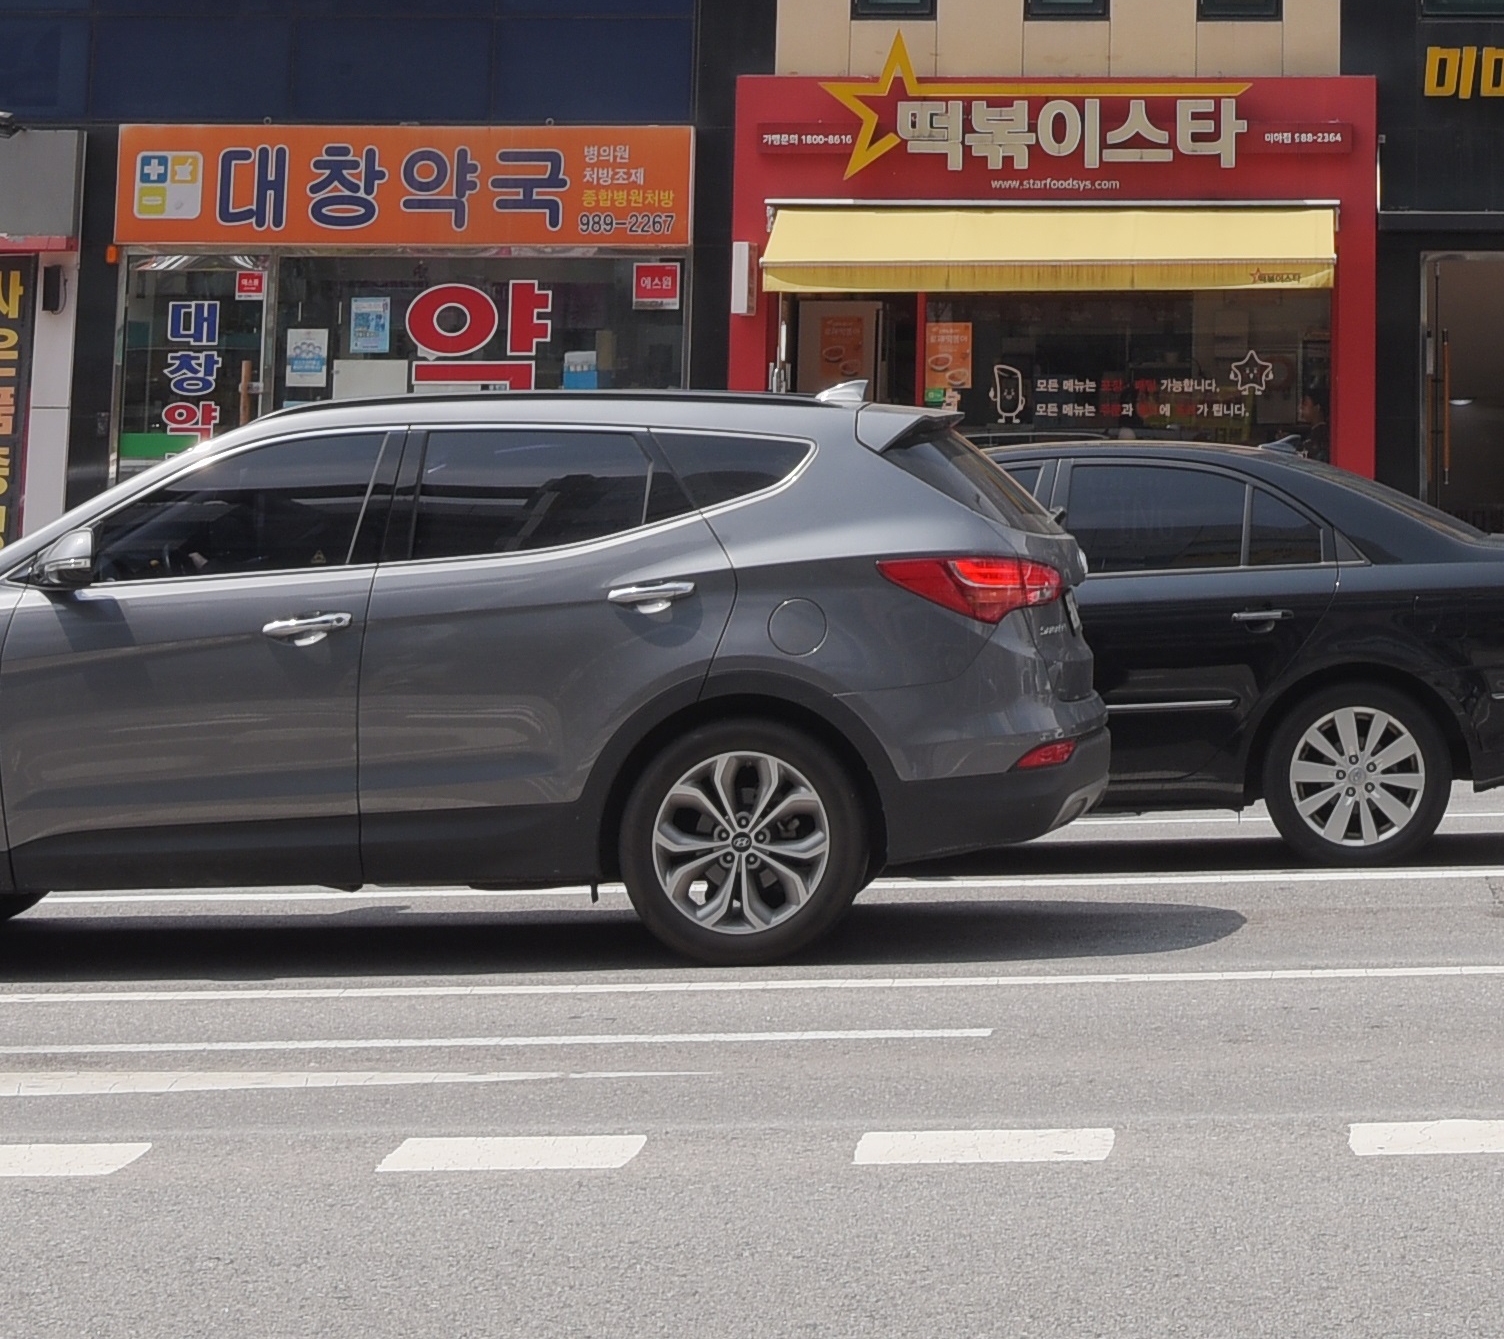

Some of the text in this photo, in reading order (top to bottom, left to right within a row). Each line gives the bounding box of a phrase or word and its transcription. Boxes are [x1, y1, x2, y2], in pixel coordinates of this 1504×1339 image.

[895, 97, 1248, 172] 떡볶이스타
[583, 145, 631, 164] 병의원
[582, 167, 645, 186] 처방조제
[990, 176, 1121, 192] www.starfoodsys.com
[216, 143, 571, 231] 대창약국
[581, 189, 676, 208] 종합병원처방
[578, 212, 677, 235] 989-2267
[1035, 378, 1059, 393] 모든
[1062, 378, 1097, 393] 메뉴는
[1160, 378, 1221, 393] 가능합니다.
[1035, 403, 1059, 418] 모든
[1062, 403, 1097, 418] 메뉴는
